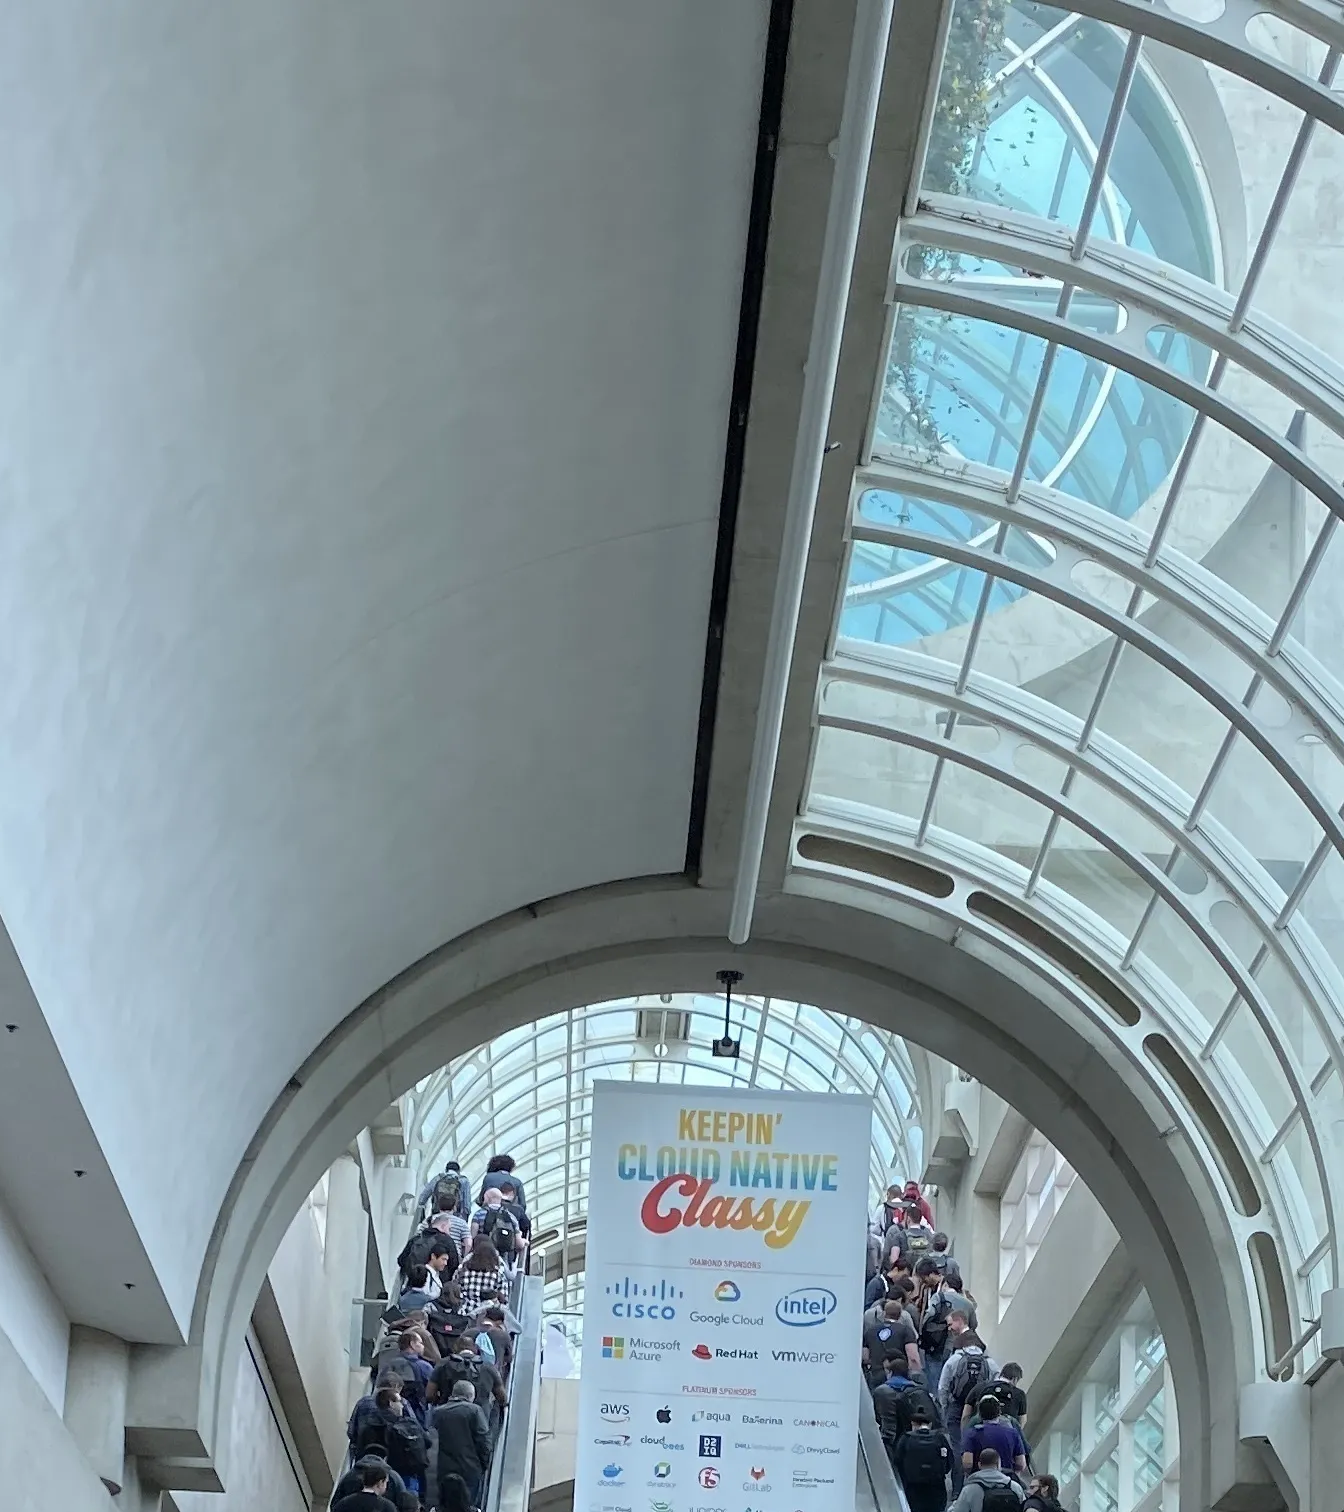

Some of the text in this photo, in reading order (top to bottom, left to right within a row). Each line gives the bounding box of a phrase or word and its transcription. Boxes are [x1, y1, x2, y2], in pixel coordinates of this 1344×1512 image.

[678, 1108, 783, 1145] KEEPIN'
[617, 1143, 839, 1191] CLOUD NATIVE
[640, 1173, 812, 1249] Classy
[723, 1259, 761, 1269] SPONSORS
[612, 1302, 676, 1320] CISCO
[783, 1295, 827, 1317] intel
[689, 1310, 764, 1326] Google Cloud
[629, 1337, 681, 1351] Microsoft
[629, 1350, 662, 1362] Azure
[715, 1348, 759, 1360] Red Hat
[771, 1349, 835, 1364] vmware
[718, 1387, 757, 1396] SPONSORS
[600, 1403, 630, 1415] aws
[706, 1412, 731, 1422] aqua
[742, 1481, 772, 1492] GitLab
